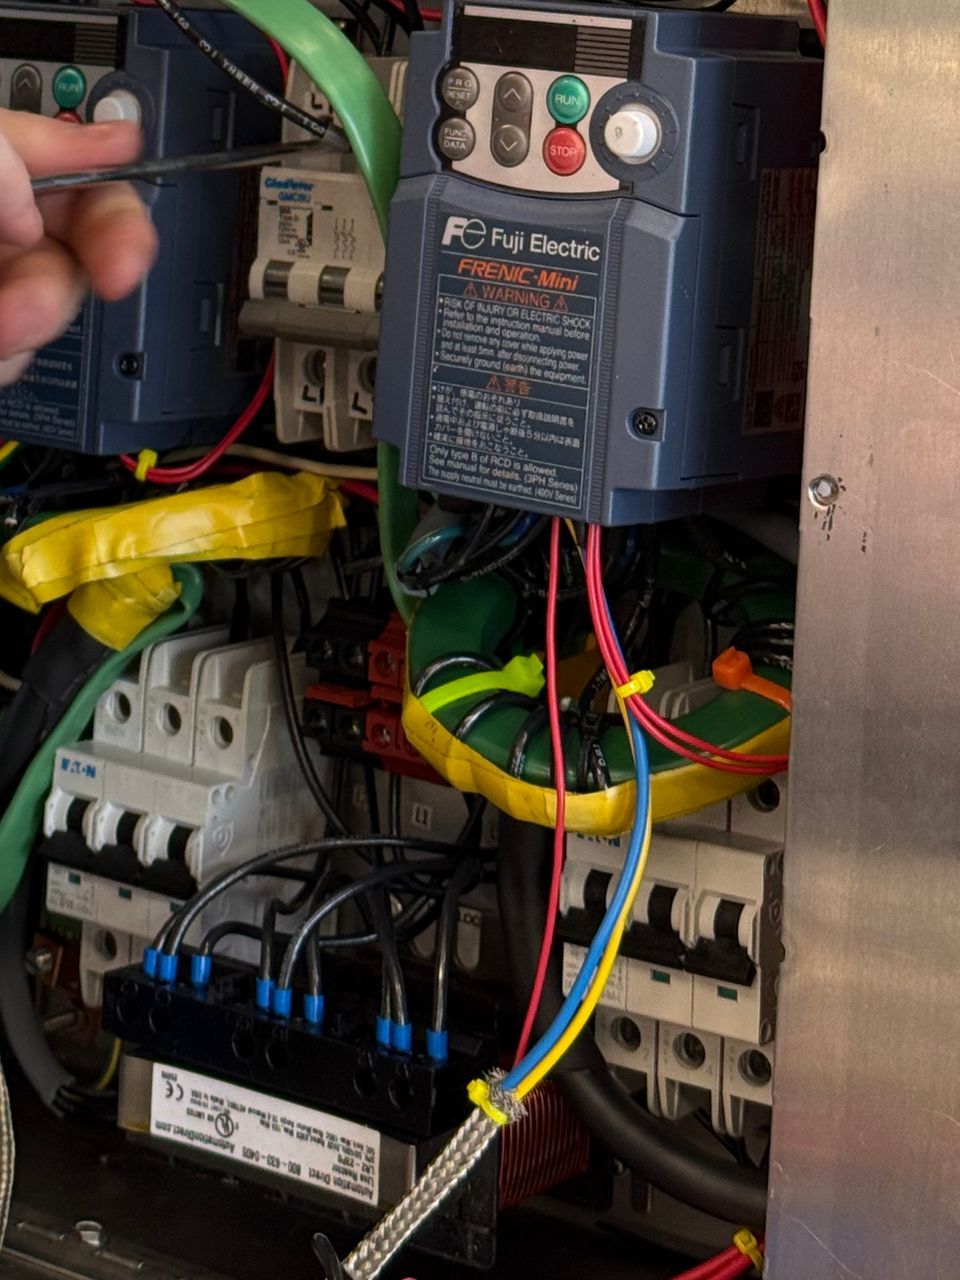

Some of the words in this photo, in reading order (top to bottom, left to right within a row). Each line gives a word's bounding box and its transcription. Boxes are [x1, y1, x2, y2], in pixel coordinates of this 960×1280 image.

[554, 93, 581, 106] RUN
[443, 127, 469, 138] FUNC
[443, 139, 466, 151] DATA
[548, 145, 578, 158] STOP
[491, 227, 525, 255] Fuji
[529, 232, 601, 262] Electric
[457, 257, 580, 292] FRENIC-Mini
[482, 283, 551, 309] WARNING
[443, 307, 465, 320] Refer
[466, 311, 475, 322] to
[476, 313, 489, 324] the
[489, 316, 531, 331] instruction
[532, 323, 563, 336] manual
[563, 328, 591, 341] before
[444, 296, 463, 310] RISK
[464, 300, 477, 311] OF
[476, 301, 506, 317] INJURY
[506, 306, 519, 318] OR
[521, 308, 561, 326] ELECTRIC
[561, 315, 592, 330] SHOCK
[442, 319, 484, 333] installation
[485, 325, 501, 336] and
[441, 327, 452, 339] Do
[488, 336, 501, 349] any
[501, 339, 520, 350] cover
[538, 345, 567, 360] applying
[440, 350, 473, 367] Securely
[473, 358, 502, 370] ground
[502, 360, 528, 376] (earth)
[529, 365, 542, 377] the
[429, 443, 449, 458] Only
[450, 448, 470, 460] type
[470, 451, 478, 462] B
[479, 454, 489, 463] of
[490, 455, 512, 468] RCD
[428, 454, 446, 466] See
[446, 459, 478, 472] manual
[478, 464, 491, 475] for
[523, 473, 547, 487] (3PH
[547, 477, 578, 494] Series)
[428, 465, 440, 477] The
[440, 470, 461, 483] supply
[460, 473, 483, 485] neutral
[483, 477, 499, 488] must
[554, 489, 577, 505] Series)
[154, 1120, 235, 1154] AutomationDirect.com
[308, 1167, 331, 1186] Direct
[331, 1163, 358, 1182] Reactor
[332, 1176, 374, 1200] Automation
